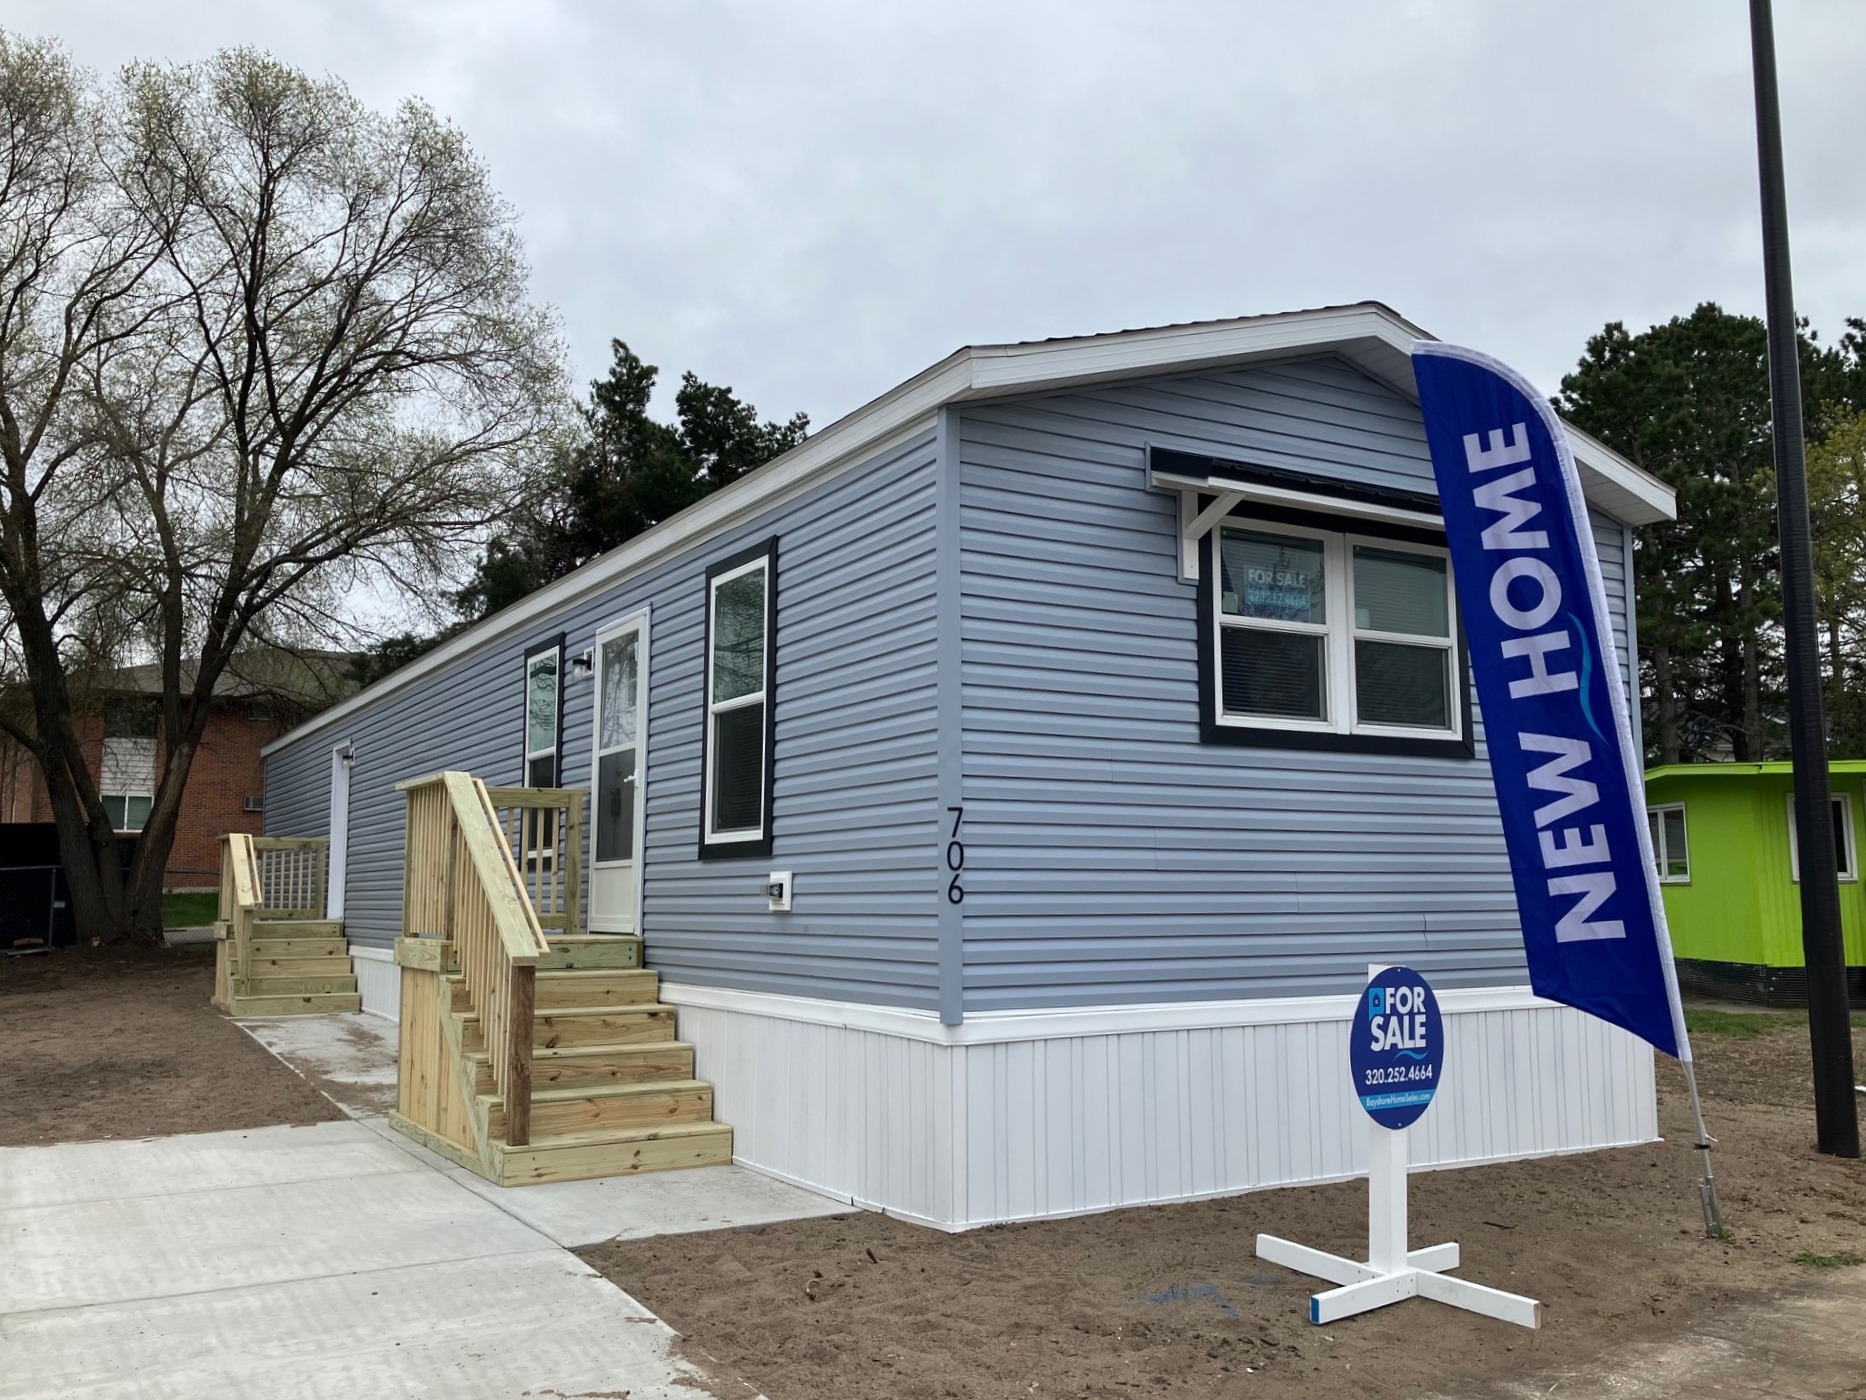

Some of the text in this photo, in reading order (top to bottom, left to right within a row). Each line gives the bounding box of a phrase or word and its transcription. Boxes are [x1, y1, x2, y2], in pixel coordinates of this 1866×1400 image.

[1248, 569, 1306, 588] FOR SALE
[1462, 422, 1626, 944] NEW HOME
[947, 807, 964, 904] 706
[1385, 986, 1426, 1014] FOR
[1370, 1014, 1426, 1052] SALE
[1365, 1064, 1433, 1085] 320.252.4664
[1366, 1093, 1431, 1109] BayshoreHomeSales.com
